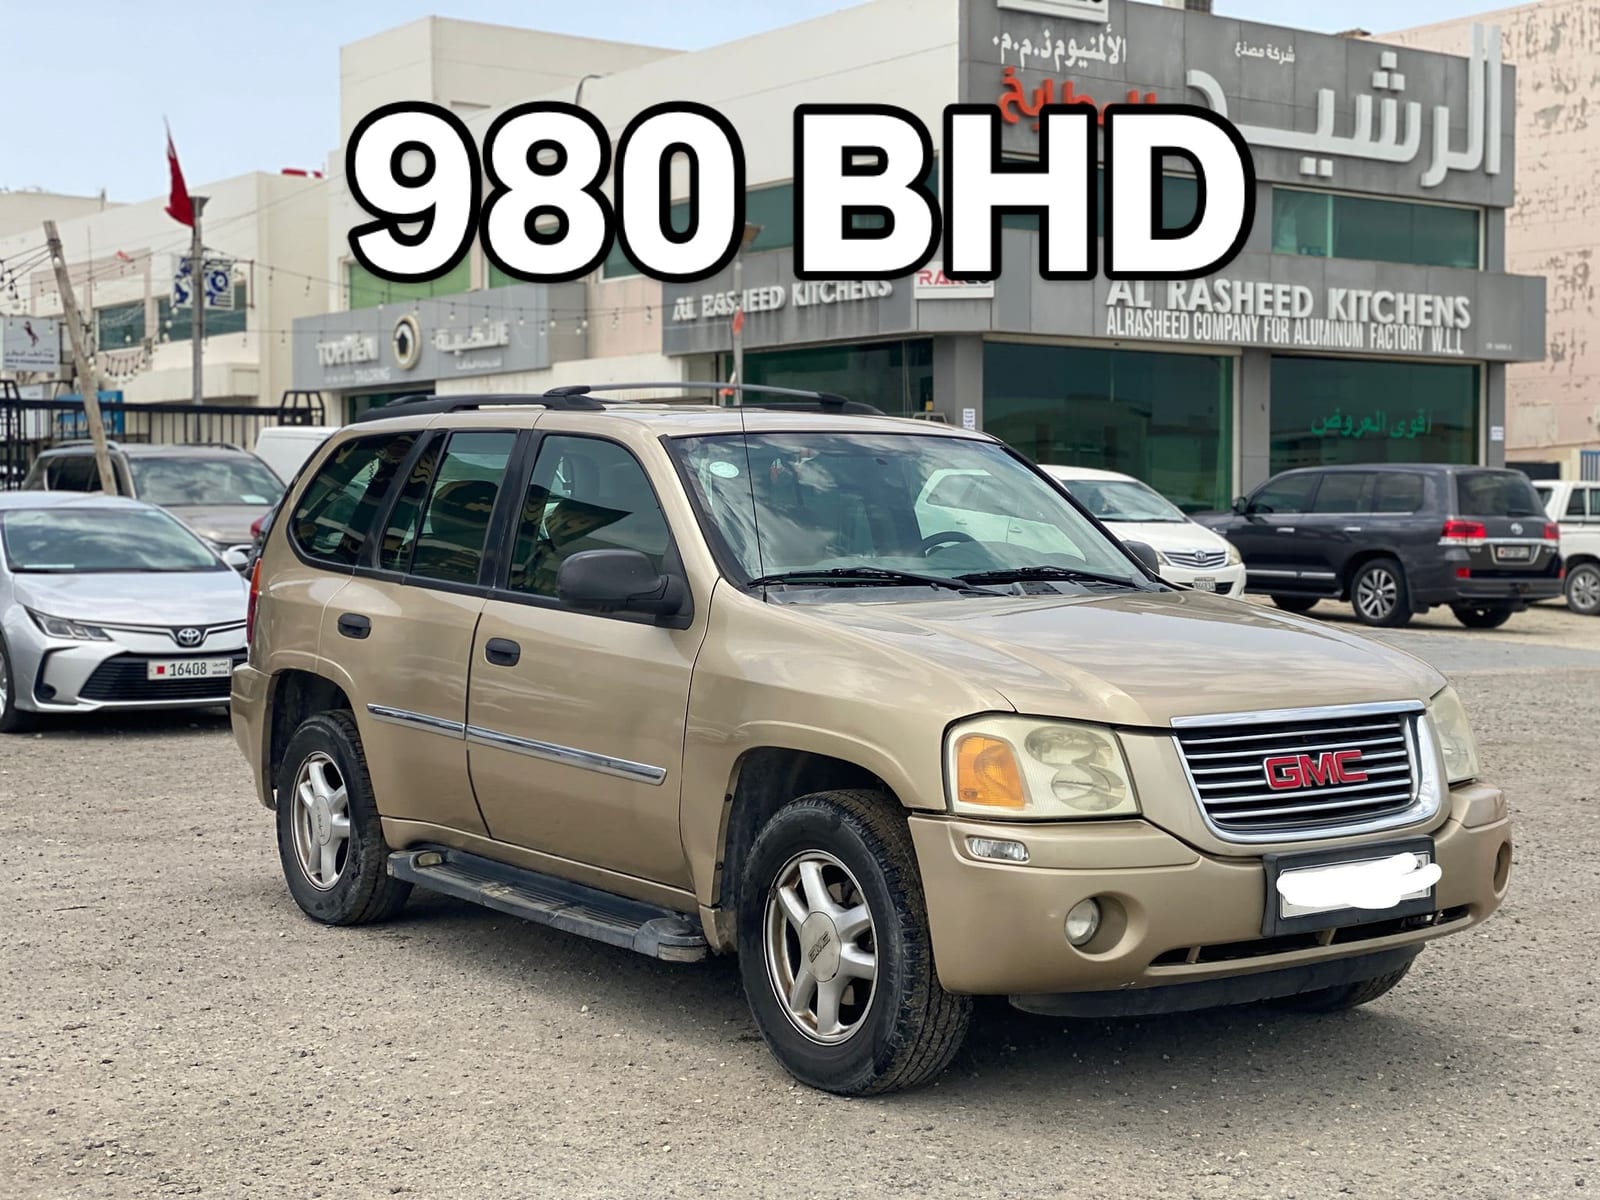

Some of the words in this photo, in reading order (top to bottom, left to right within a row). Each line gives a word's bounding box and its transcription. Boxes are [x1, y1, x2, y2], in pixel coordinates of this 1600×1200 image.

[1186, 22, 1501, 187] الرشيد
[791, 279, 893, 307] KITCHENS
[1105, 280, 1153, 308] AL
[1167, 279, 1314, 318] RASHEED
[1328, 287, 1472, 329] KITCHENS
[1106, 306, 1189, 339] ALRASHEED
[1193, 312, 1260, 343] COMPANY
[1264, 317, 1290, 344] FOR
[1294, 318, 1364, 348] ALUMINUM
[1370, 323, 1425, 350] FACTORY
[1311, 407, 1386, 437] العروض
[169, 662, 207, 677] 16408
[1264, 749, 1369, 791] GMC
